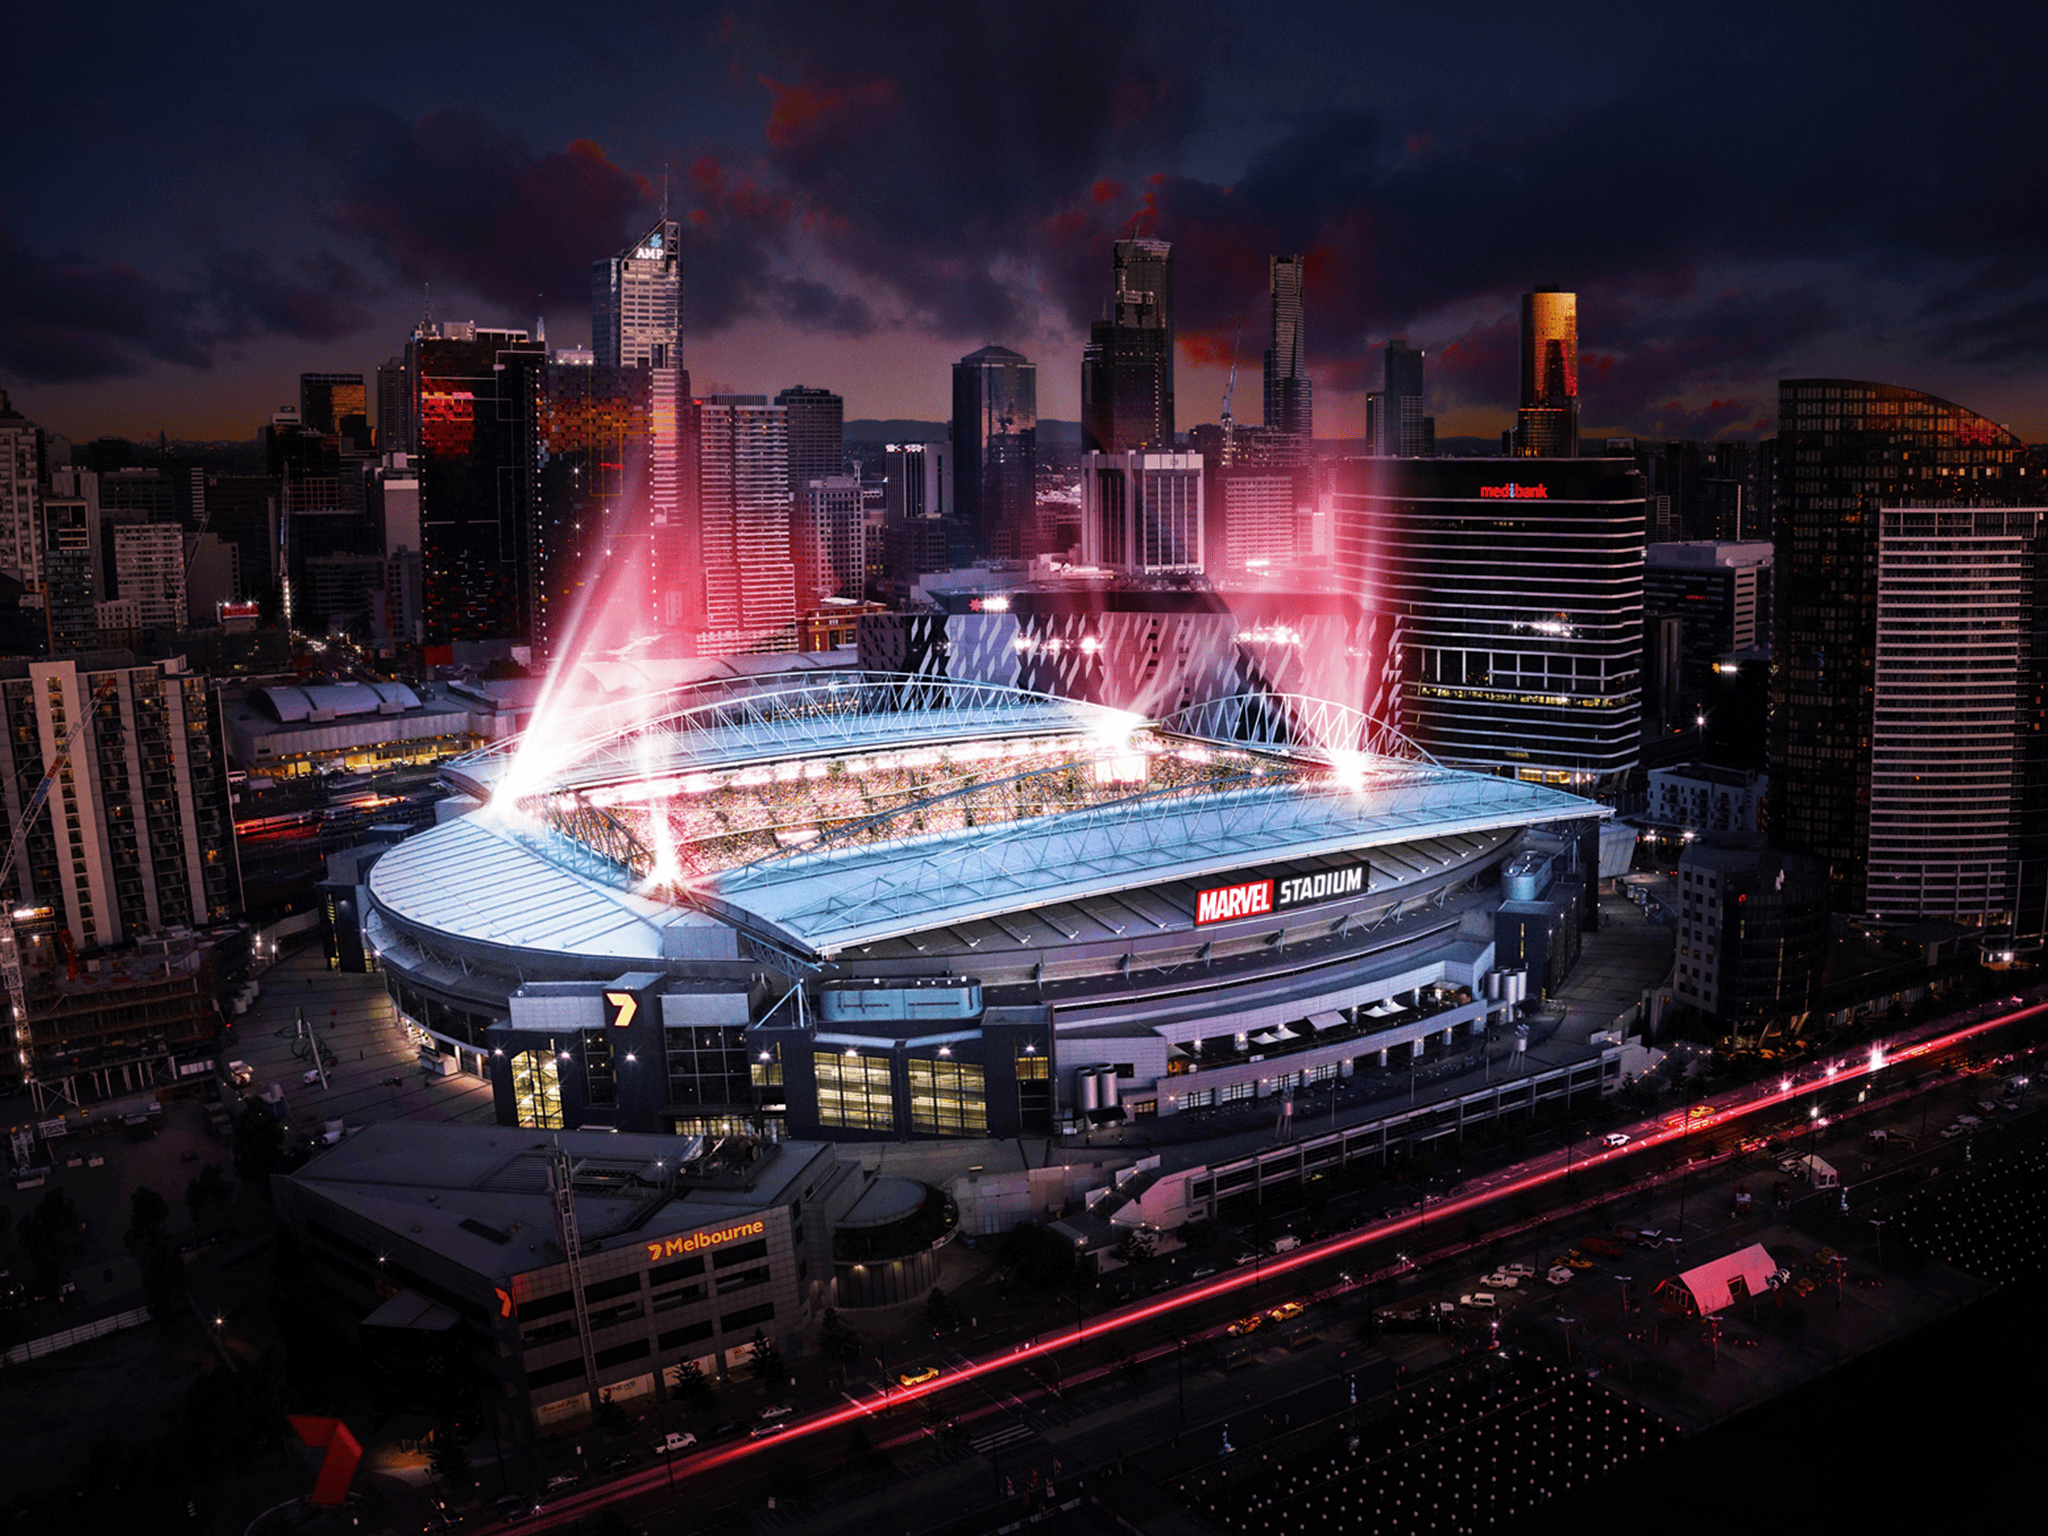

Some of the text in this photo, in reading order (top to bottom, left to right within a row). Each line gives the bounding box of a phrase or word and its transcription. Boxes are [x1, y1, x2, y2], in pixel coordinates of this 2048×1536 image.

[636, 247, 664, 260] AMP
[1480, 482, 1548, 498] medibank
[1198, 867, 1363, 923] MARVEL STADIUM
[647, 1220, 764, 1261] 7 Melbourne
